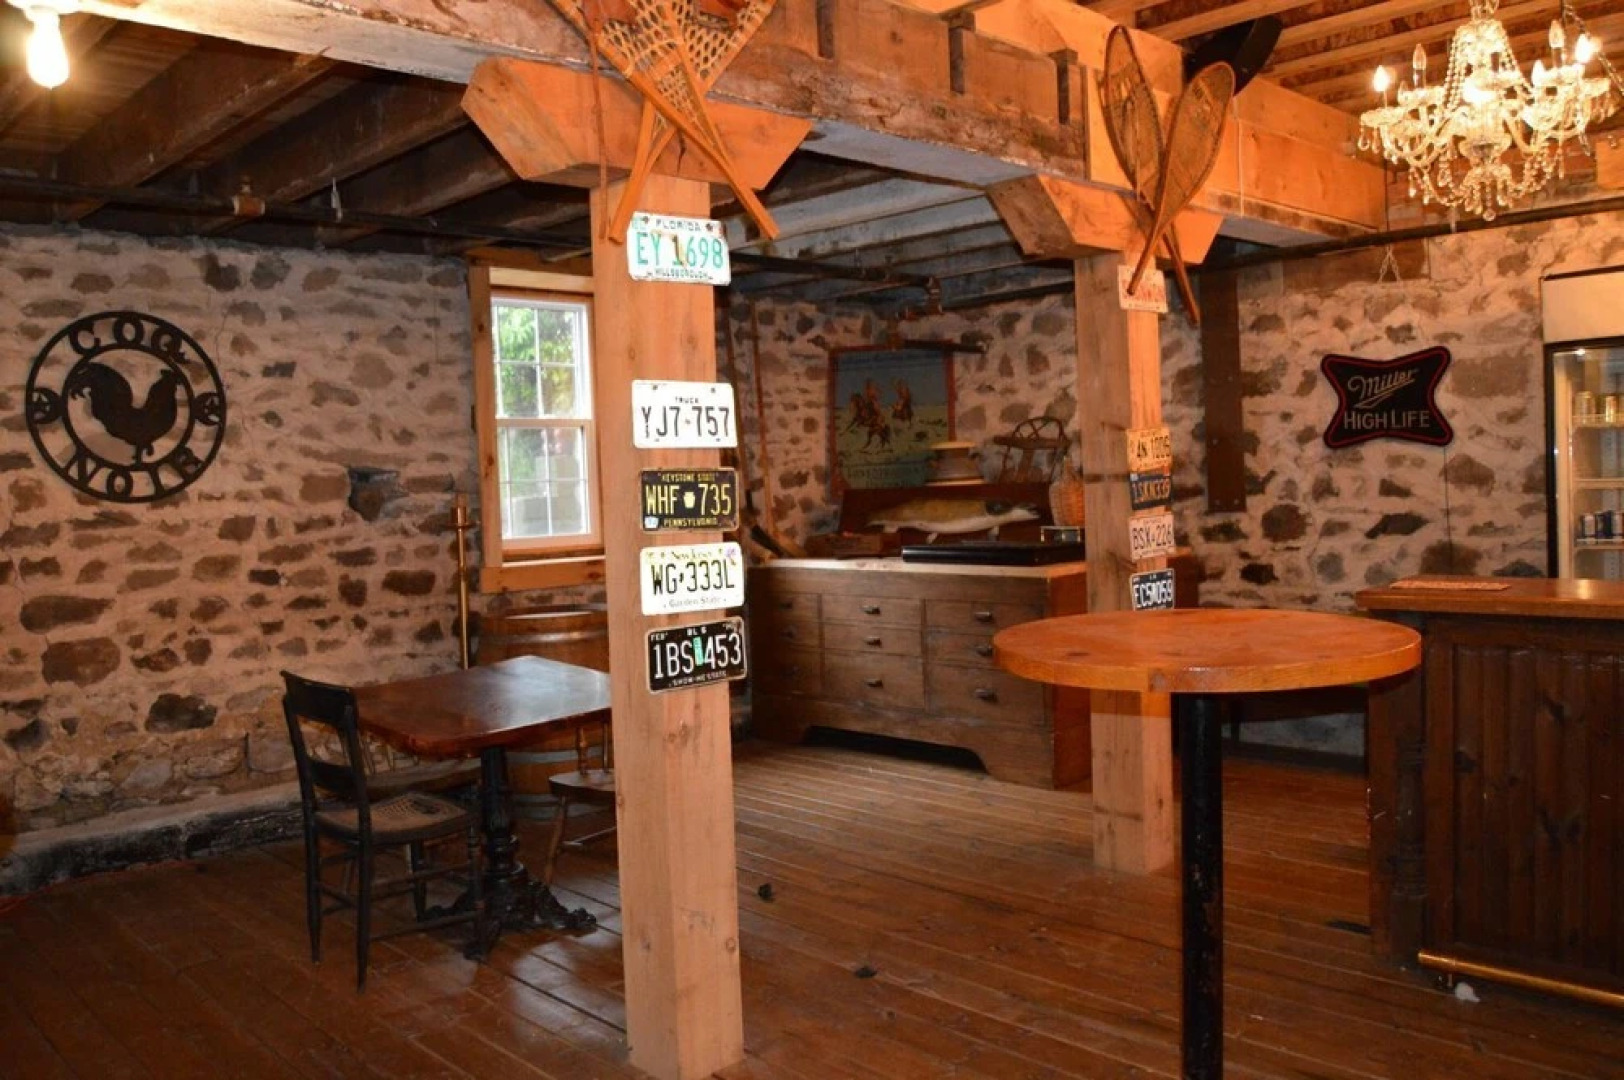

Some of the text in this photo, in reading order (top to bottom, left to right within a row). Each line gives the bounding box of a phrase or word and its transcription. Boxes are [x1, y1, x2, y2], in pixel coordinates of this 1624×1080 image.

[656, 219, 701, 231] FLORIDA
[637, 231, 724, 269] EY 1698
[1347, 367, 1419, 399] Miller
[1344, 409, 1430, 430] HIGH LIFE
[645, 483, 732, 516] WHF 735
